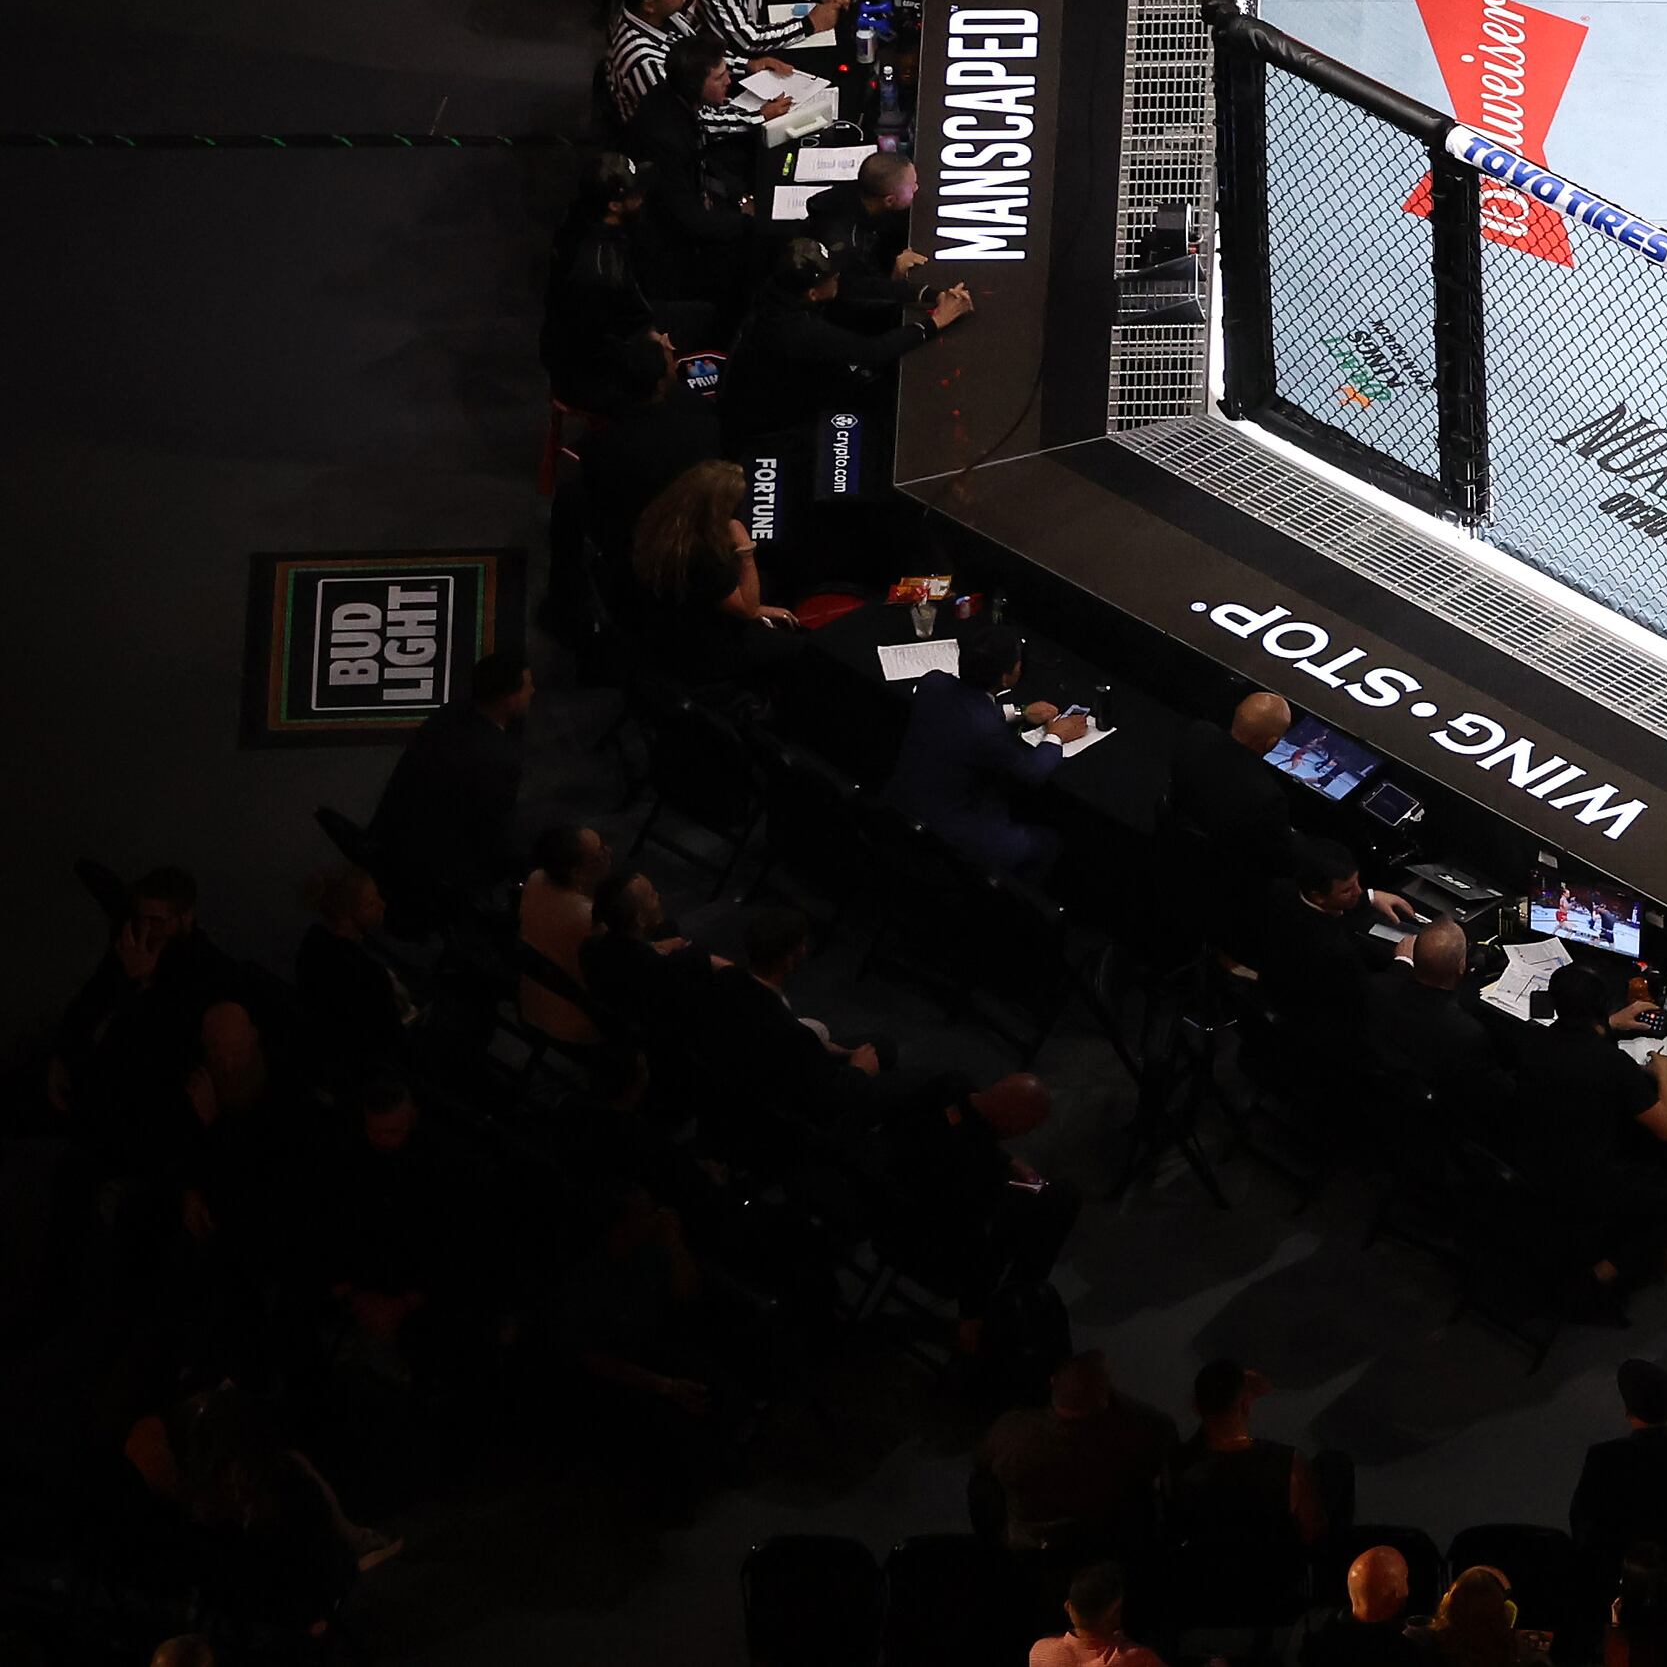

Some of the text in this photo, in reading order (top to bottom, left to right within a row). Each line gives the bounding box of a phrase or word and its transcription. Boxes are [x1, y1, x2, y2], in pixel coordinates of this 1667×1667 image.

[934, 8, 1040, 260] MANSCAPED
[1463, 136, 1568, 203] TOYO
[751, 456, 778, 540] FORTUNE
[832, 429, 848, 494] crypto.com
[329, 602, 382, 686] BUD
[383, 585, 438, 701] LIGHT
